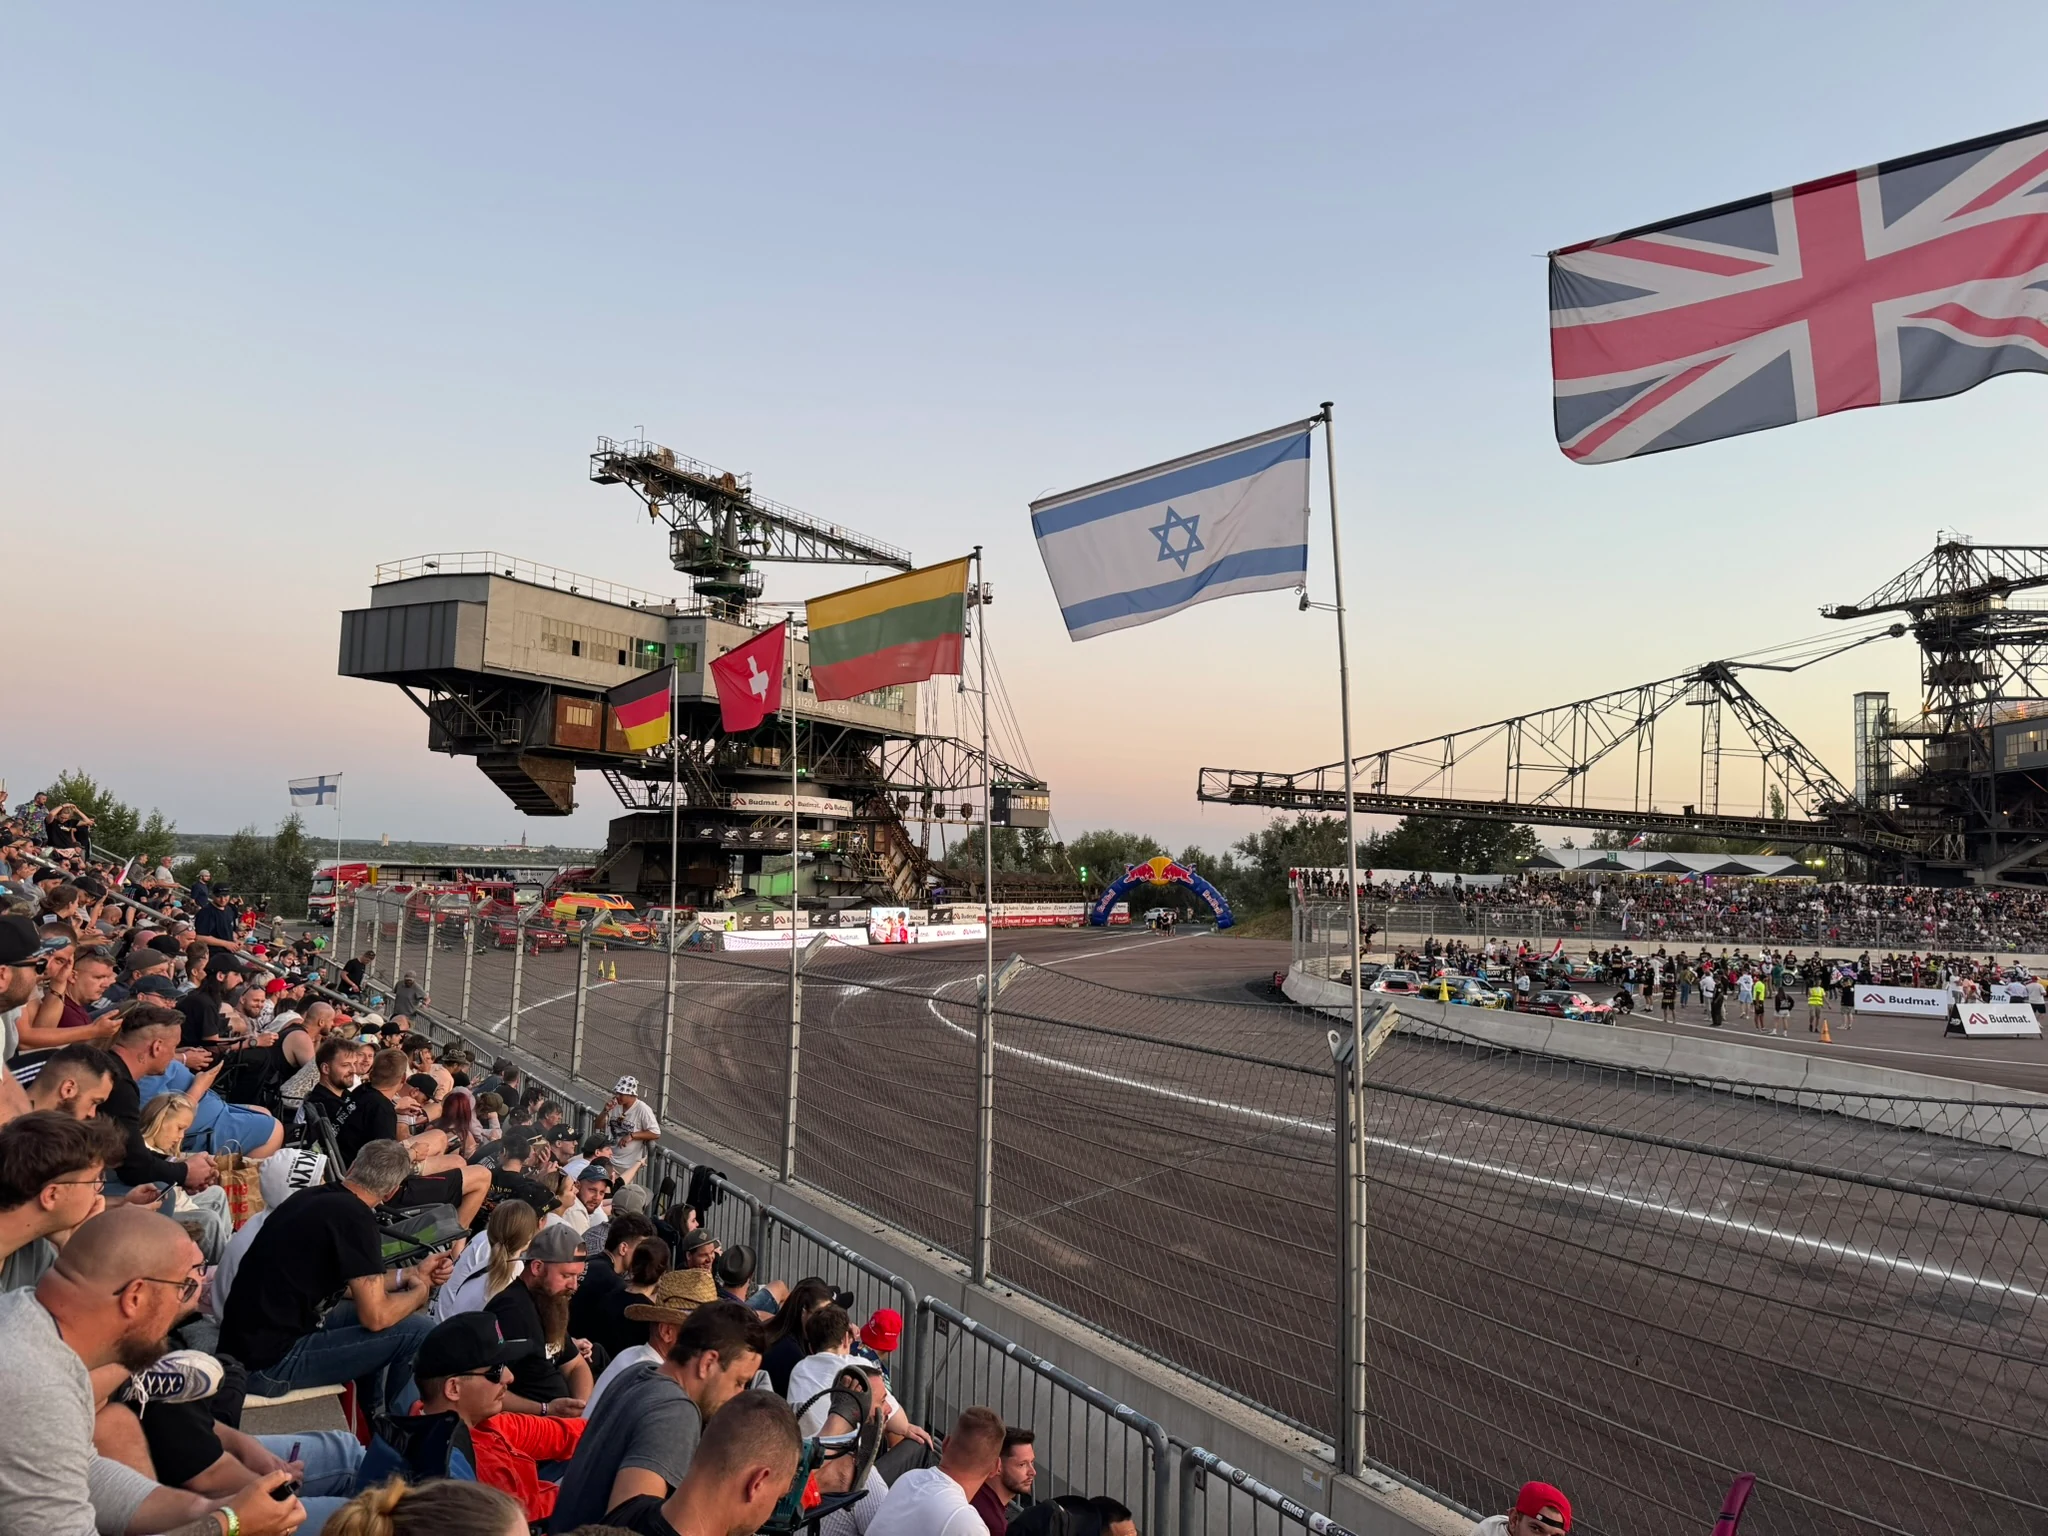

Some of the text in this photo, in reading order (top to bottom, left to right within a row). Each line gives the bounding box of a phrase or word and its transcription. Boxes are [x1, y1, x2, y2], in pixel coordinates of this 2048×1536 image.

[748, 799, 780, 807] Budmat.
[1888, 995, 1940, 1007] Budmat.
[1989, 1014, 2031, 1024] Budmat.
[1281, 1500, 1305, 1519] EIMS
